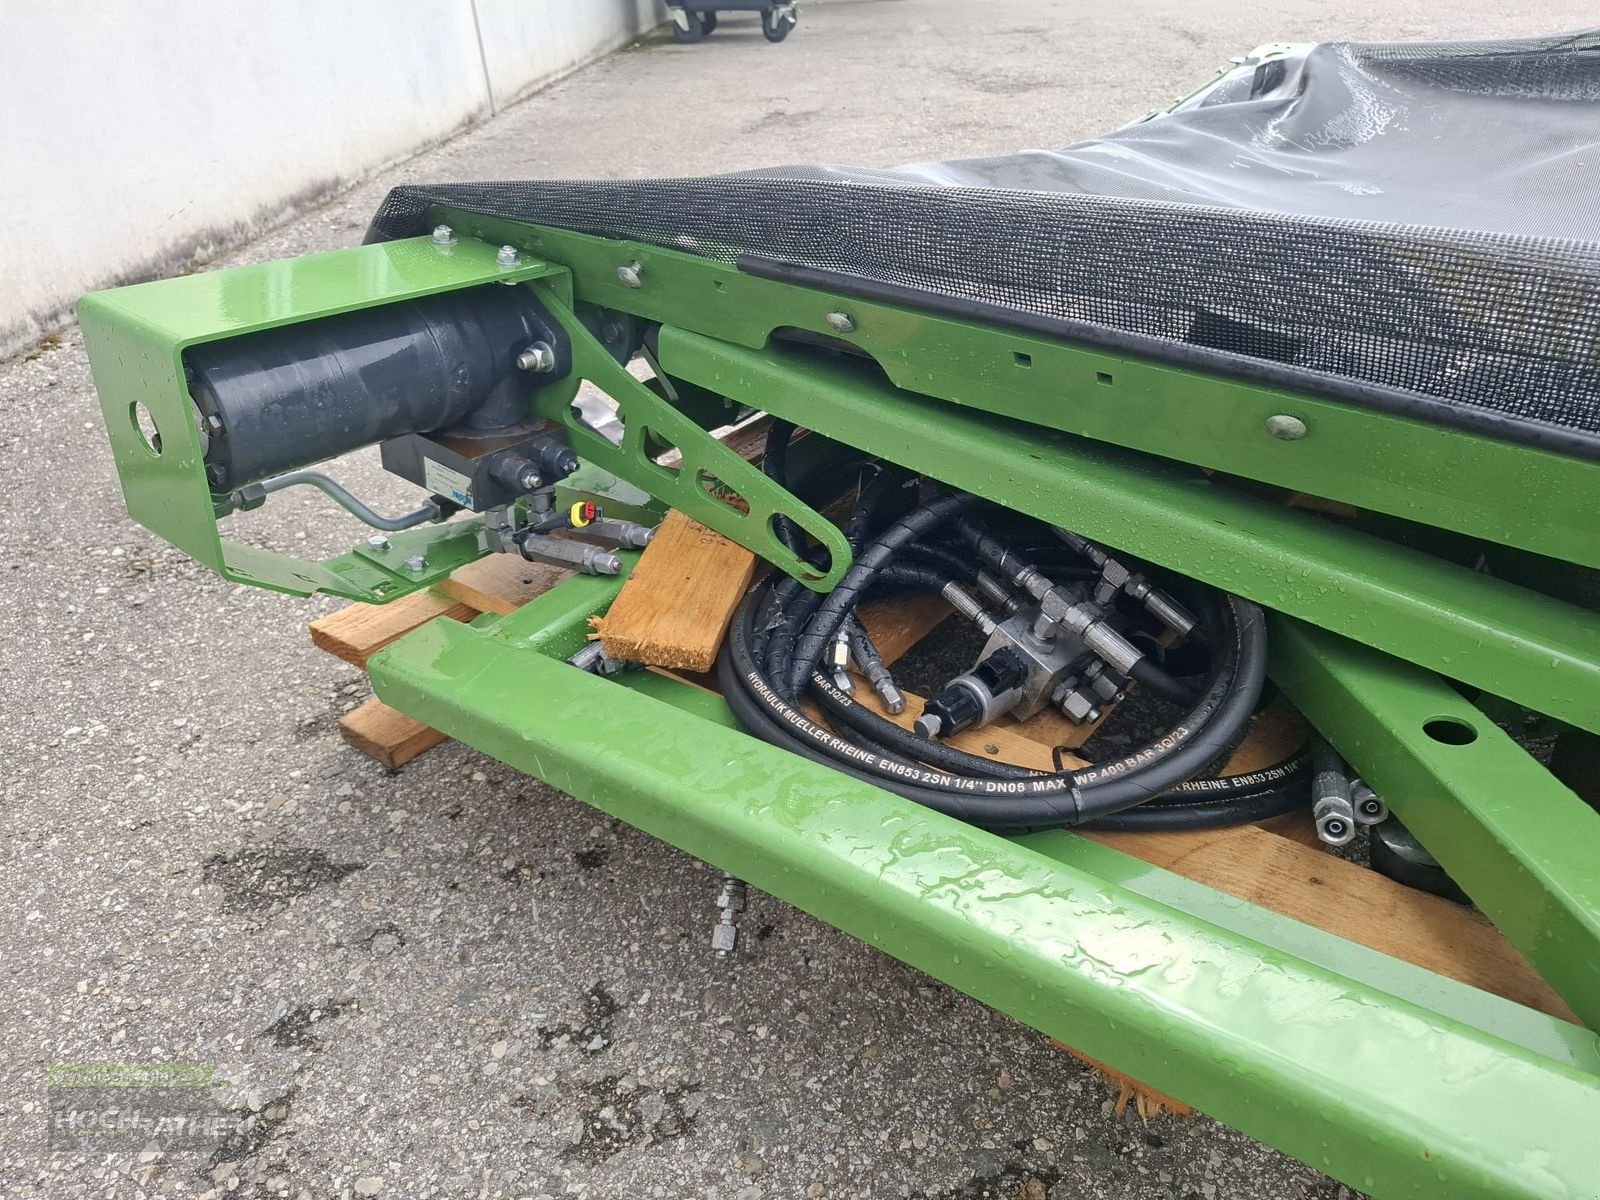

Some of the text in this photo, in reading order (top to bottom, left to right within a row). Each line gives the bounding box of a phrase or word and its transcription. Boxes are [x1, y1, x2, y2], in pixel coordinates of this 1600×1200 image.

[812, 673, 832, 691] BAR
[828, 687, 853, 707] 3Q/23
[747, 671, 787, 714] HYDRAULIK
[783, 709, 834, 745] MUELLER
[829, 735, 876, 764] RHEINE
[879, 759, 920, 780] EN853
[921, 771, 951, 787] 2SN
[986, 781, 1025, 793] DN06
[1033, 778, 1067, 792] MAX
[1074, 773, 1097, 786] WP
[1100, 762, 1126, 778] 400
[1124, 749, 1158, 769] BAR
[1154, 726, 1189, 753] 3Q/23
[1182, 779, 1230, 791] RHEINE
[1232, 773, 1266, 787] EN853
[1264, 767, 1286, 781] 2SN
